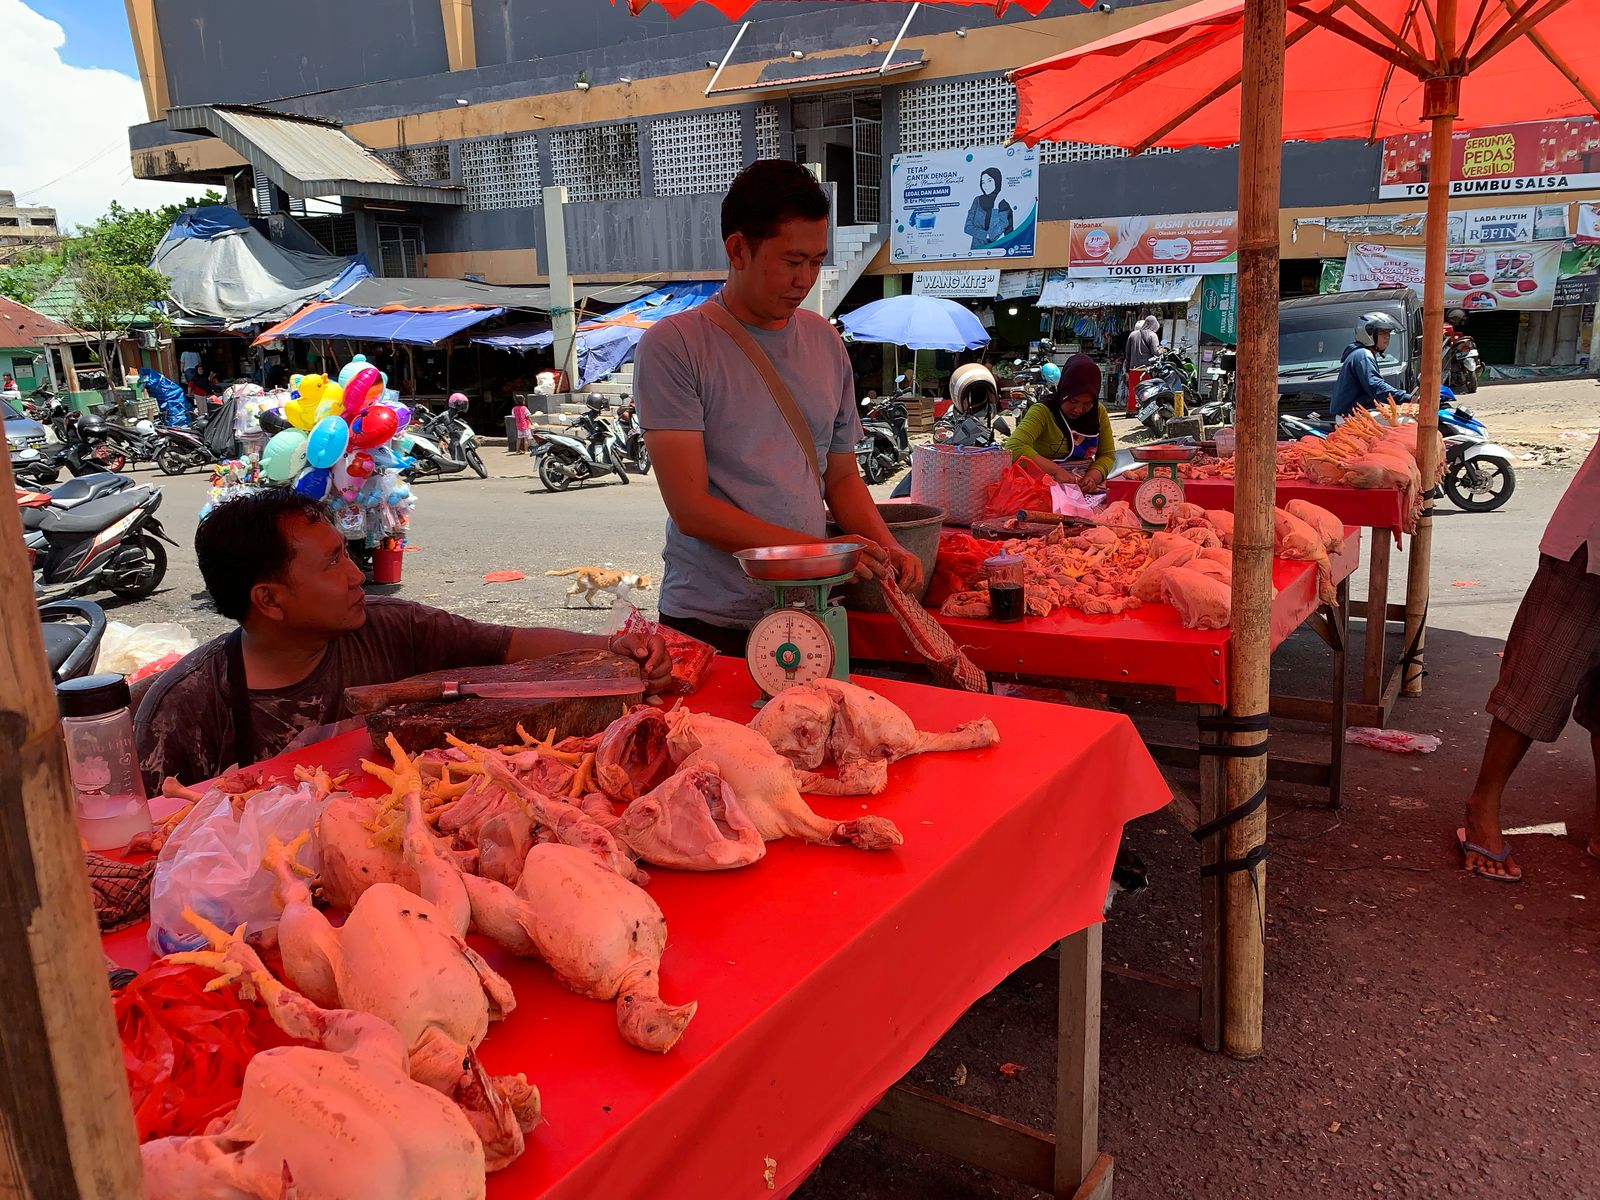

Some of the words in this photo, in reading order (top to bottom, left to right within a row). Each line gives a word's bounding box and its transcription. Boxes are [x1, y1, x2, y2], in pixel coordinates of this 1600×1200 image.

[1466, 136, 1514, 149] SERUNYA
[1465, 148, 1513, 164] PEDAS
[906, 166, 928, 174] TETAP
[1463, 165, 1492, 176] VERSI
[1495, 163, 1513, 173] LO!
[906, 173, 930, 181] CANTIK
[930, 171, 957, 179] DENGAN
[1453, 180, 1511, 193] BUMBU
[1515, 176, 1569, 189] SALSA
[1188, 218, 1215, 228] KUTU
[1215, 217, 1233, 226] AIR
[1500, 213, 1527, 221] PUTIH
[1073, 221, 1103, 229] Kalpanax
[1470, 227, 1529, 240] REFINA
[1108, 267, 1141, 276] TOKO
[1147, 264, 1195, 275] BHEKTI
[1369, 267, 1419, 275] GRATIS
